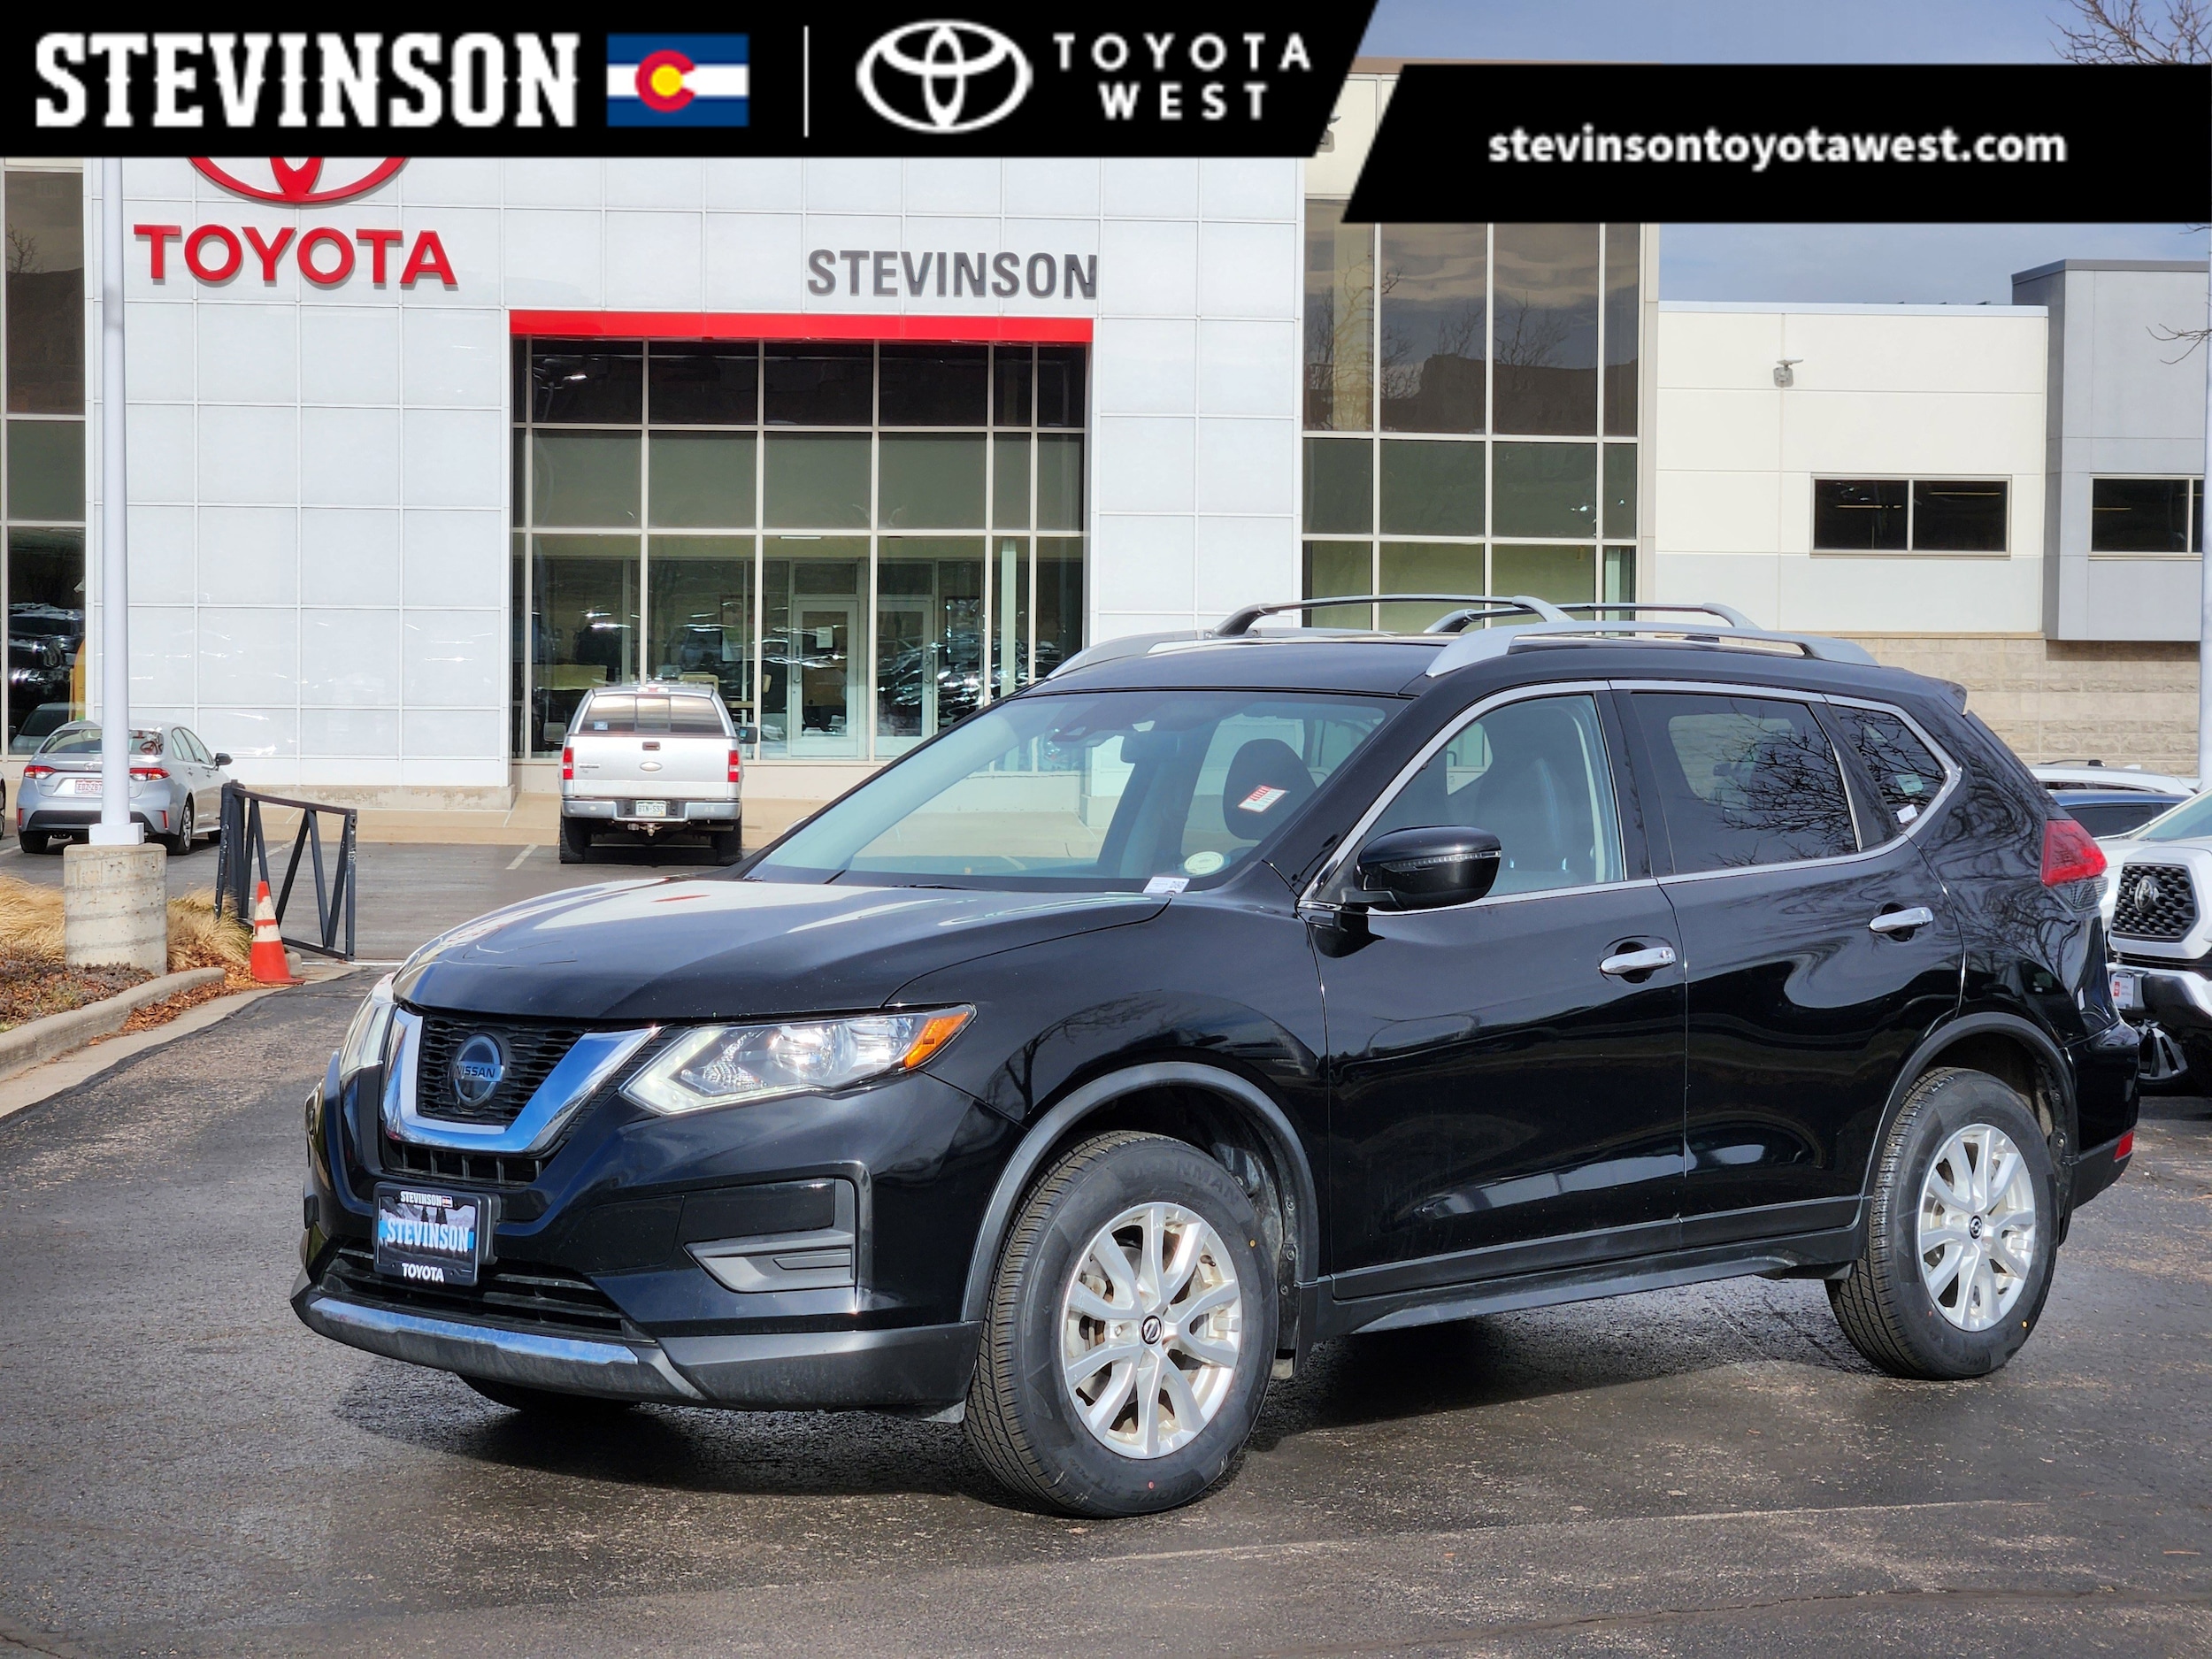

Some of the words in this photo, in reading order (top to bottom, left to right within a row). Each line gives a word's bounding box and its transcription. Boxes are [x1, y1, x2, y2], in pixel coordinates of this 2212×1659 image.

[134, 224, 458, 286] TOYOTA
[808, 249, 1097, 299] STEVINSON
[457, 1064, 495, 1078] NISSAN
[400, 1191, 442, 1207] STEVINSON
[388, 1217, 469, 1253] STEVINSON
[402, 1263, 444, 1282] TOYOTA
